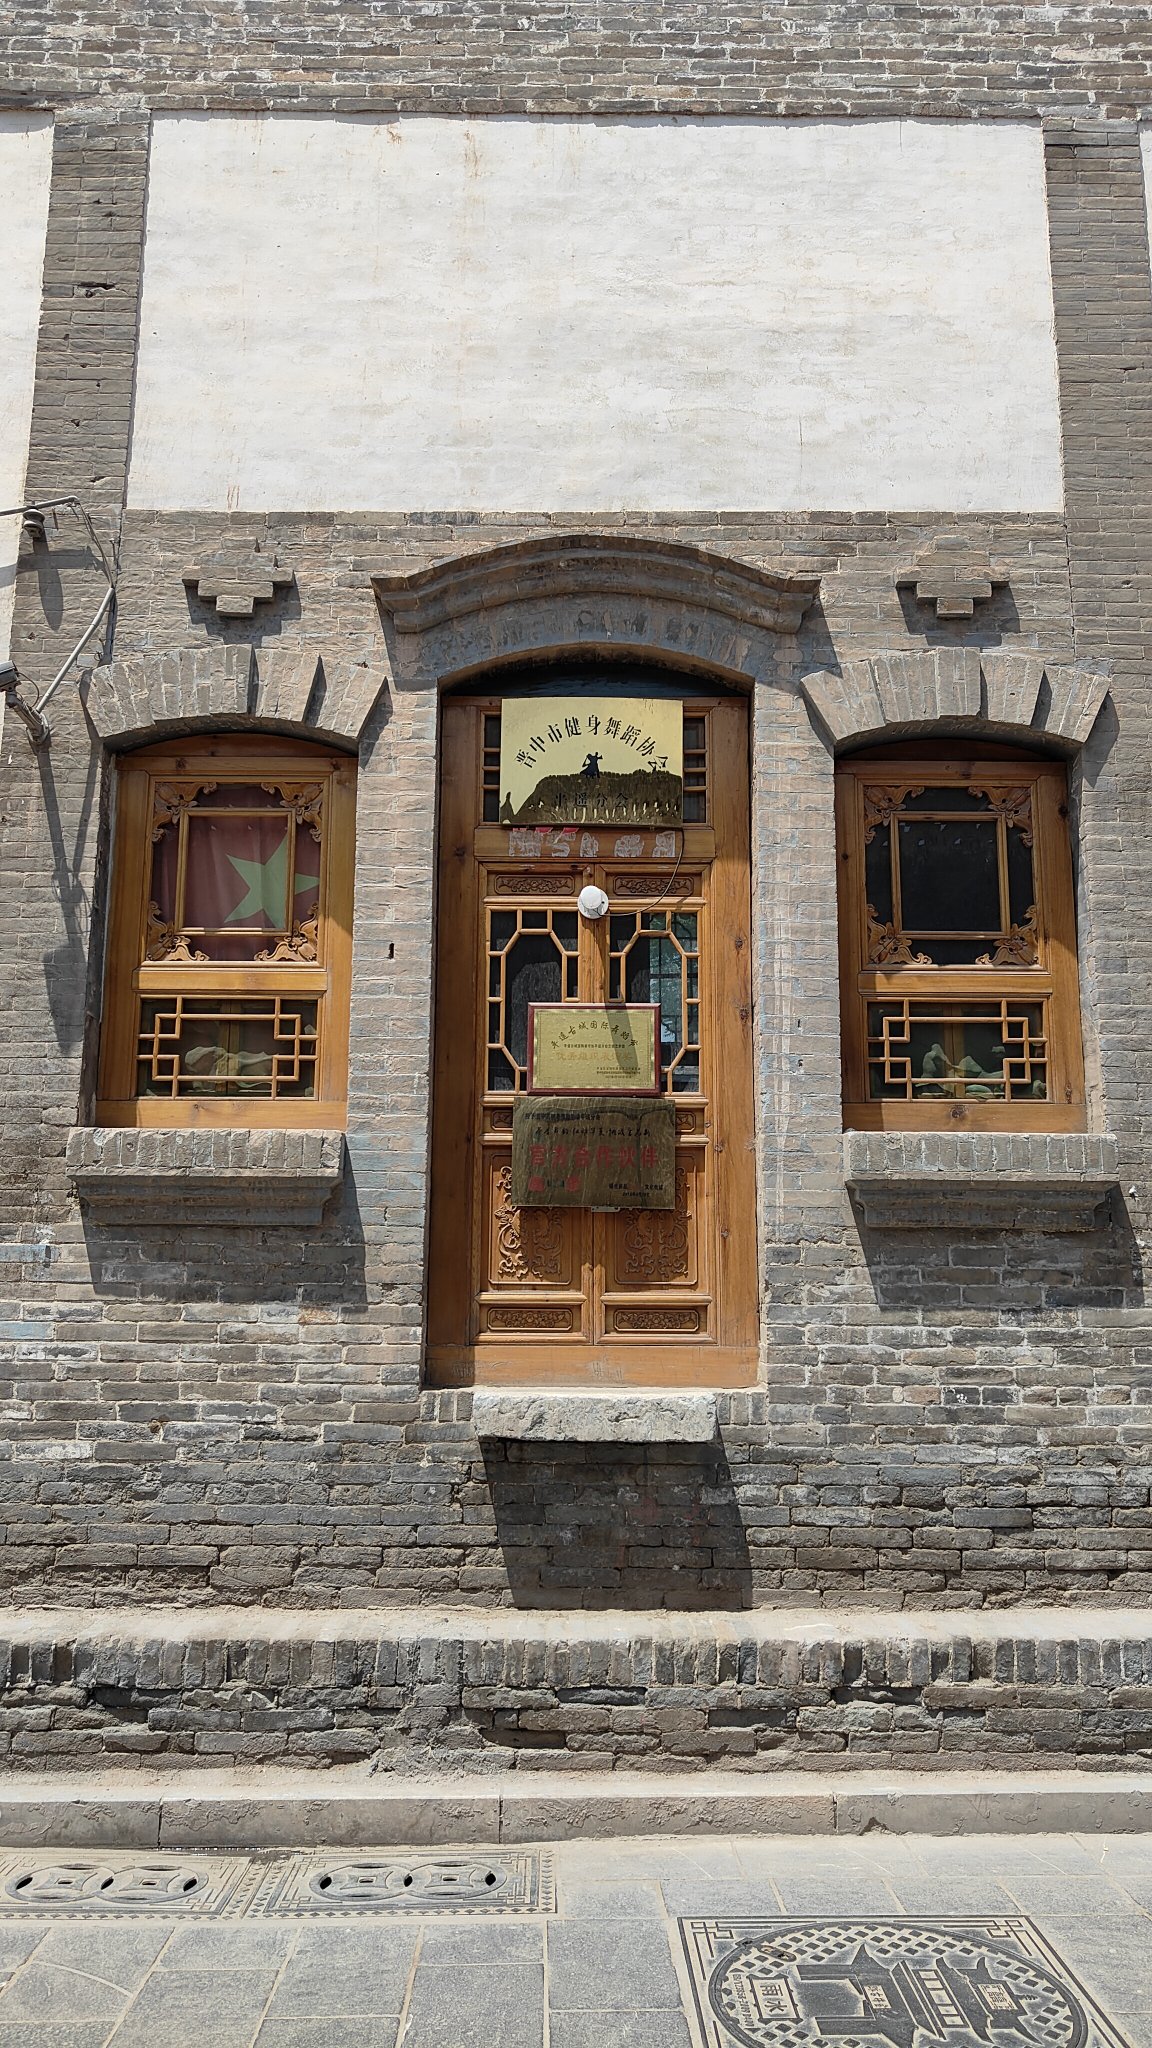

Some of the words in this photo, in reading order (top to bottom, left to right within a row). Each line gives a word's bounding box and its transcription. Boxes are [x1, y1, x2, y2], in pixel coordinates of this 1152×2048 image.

[515, 715, 669, 773] 晋中市健身舞蹈协会
[529, 1144, 659, 1169] 官方合作伙伴
[761, 1984, 786, 2013] 雨水
